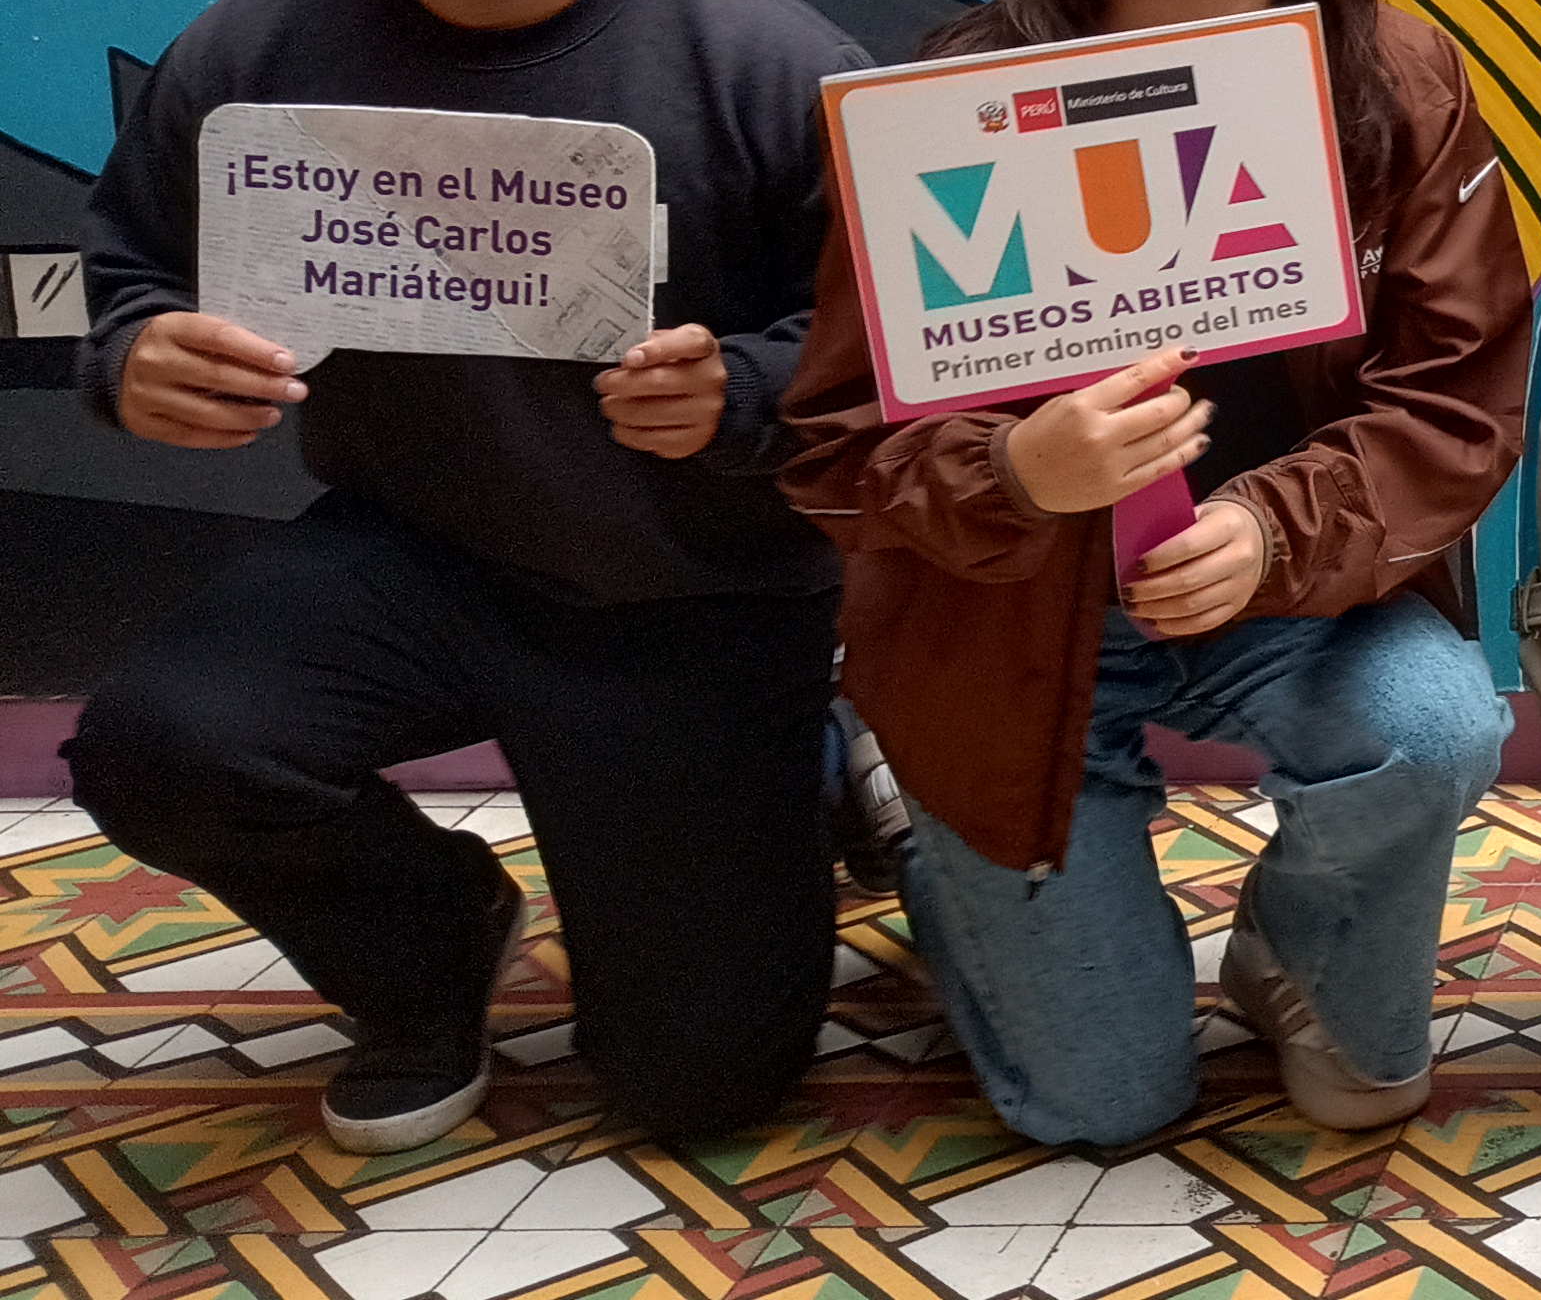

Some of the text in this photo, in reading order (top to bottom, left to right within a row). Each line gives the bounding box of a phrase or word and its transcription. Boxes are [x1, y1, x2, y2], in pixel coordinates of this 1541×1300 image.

[1019, 97, 1058, 119] PERÚ
[227, 154, 628, 210] ¡Estoy en el Museo
[300, 209, 552, 257] José Carlos
[910, 123, 1300, 312] MUA
[304, 259, 549, 311] Mariátegui!
[922, 261, 1304, 351] MUSEOS ABIERTOS
[931, 299, 1308, 383] Primer domingo del mes
